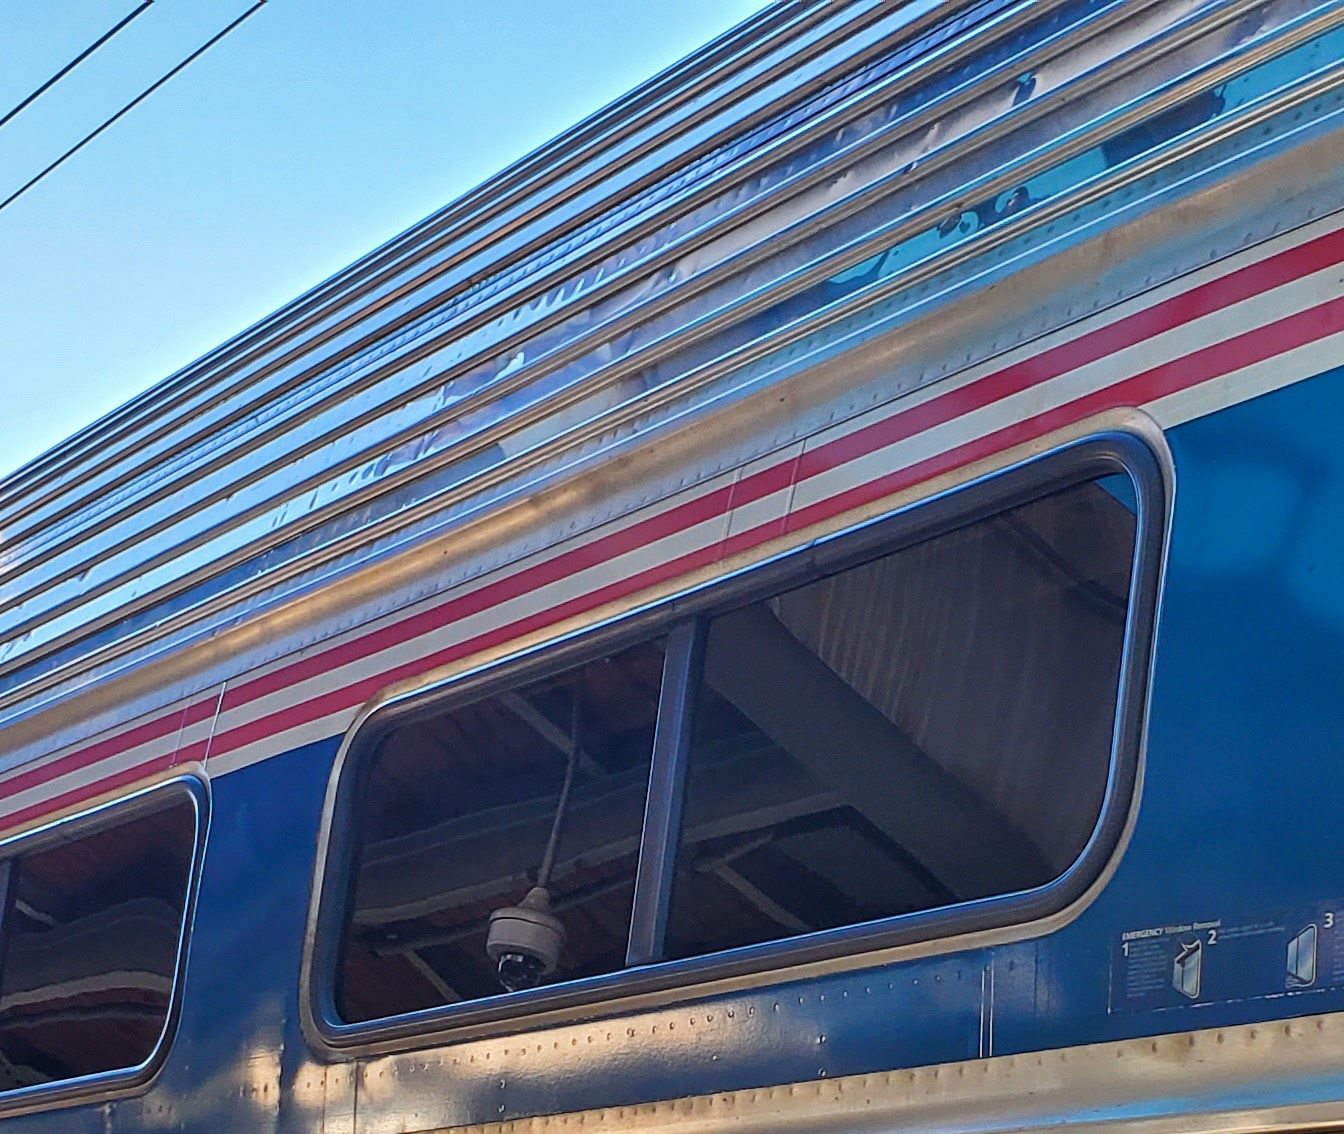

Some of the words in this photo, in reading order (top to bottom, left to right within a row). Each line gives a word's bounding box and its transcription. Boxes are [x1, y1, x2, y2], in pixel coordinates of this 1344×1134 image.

[1323, 912, 1335, 929] 3
[1121, 927, 1164, 941] EMERGENCY
[1207, 929, 1218, 945] 2
[1121, 941, 1130, 957] 1
